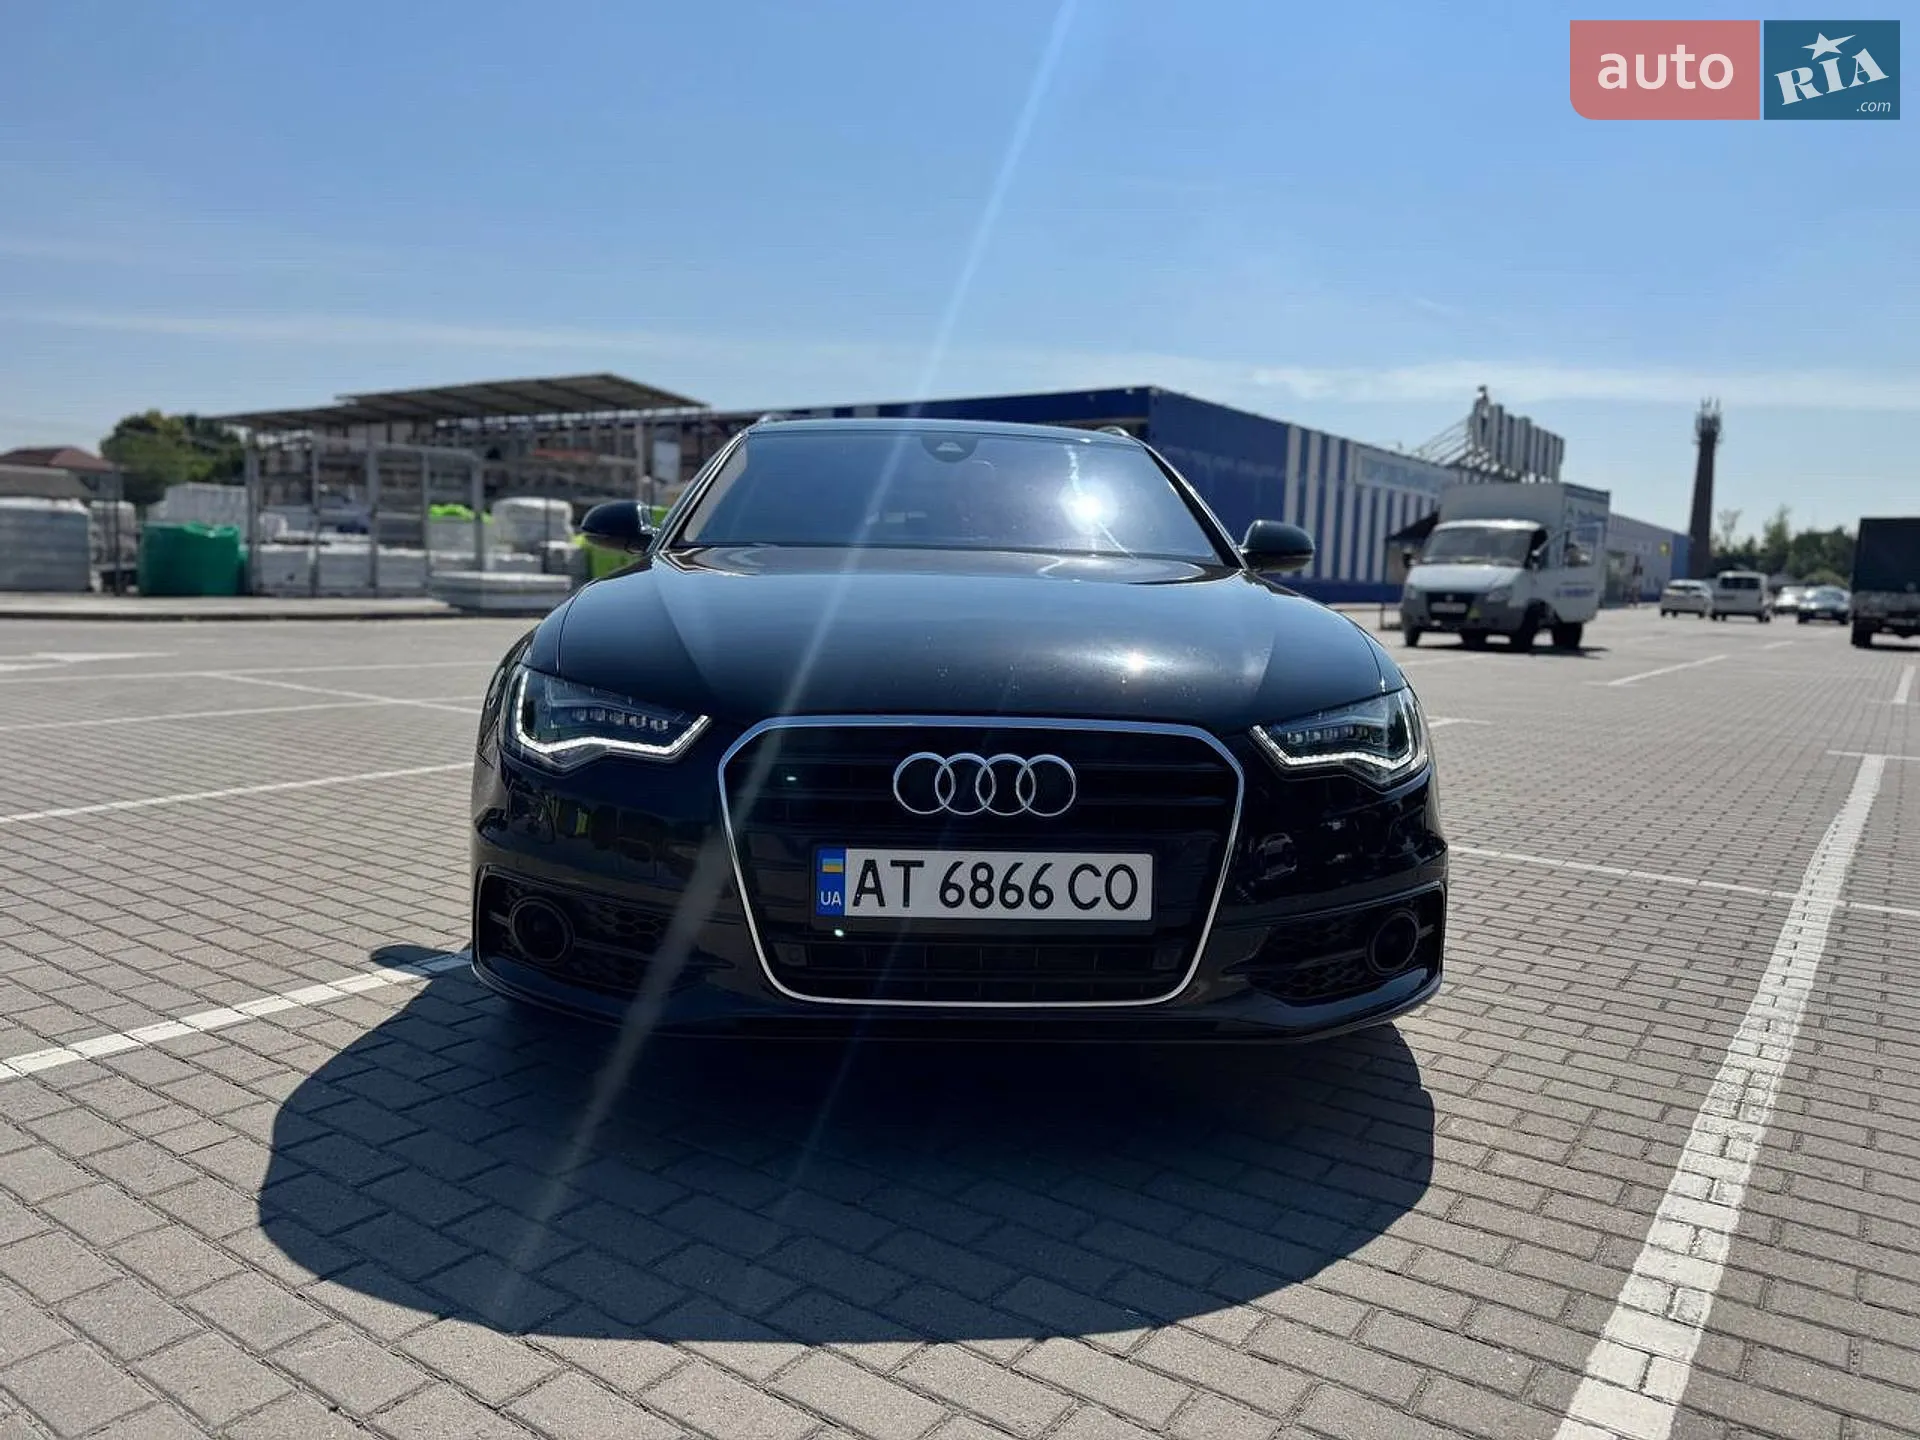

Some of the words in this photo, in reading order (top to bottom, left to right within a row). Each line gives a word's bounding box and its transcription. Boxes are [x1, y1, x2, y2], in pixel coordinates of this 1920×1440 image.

[820, 891, 842, 906] UA
[853, 859, 924, 907] AT
[939, 861, 1054, 909] 6866
[1068, 863, 1138, 910] CO
